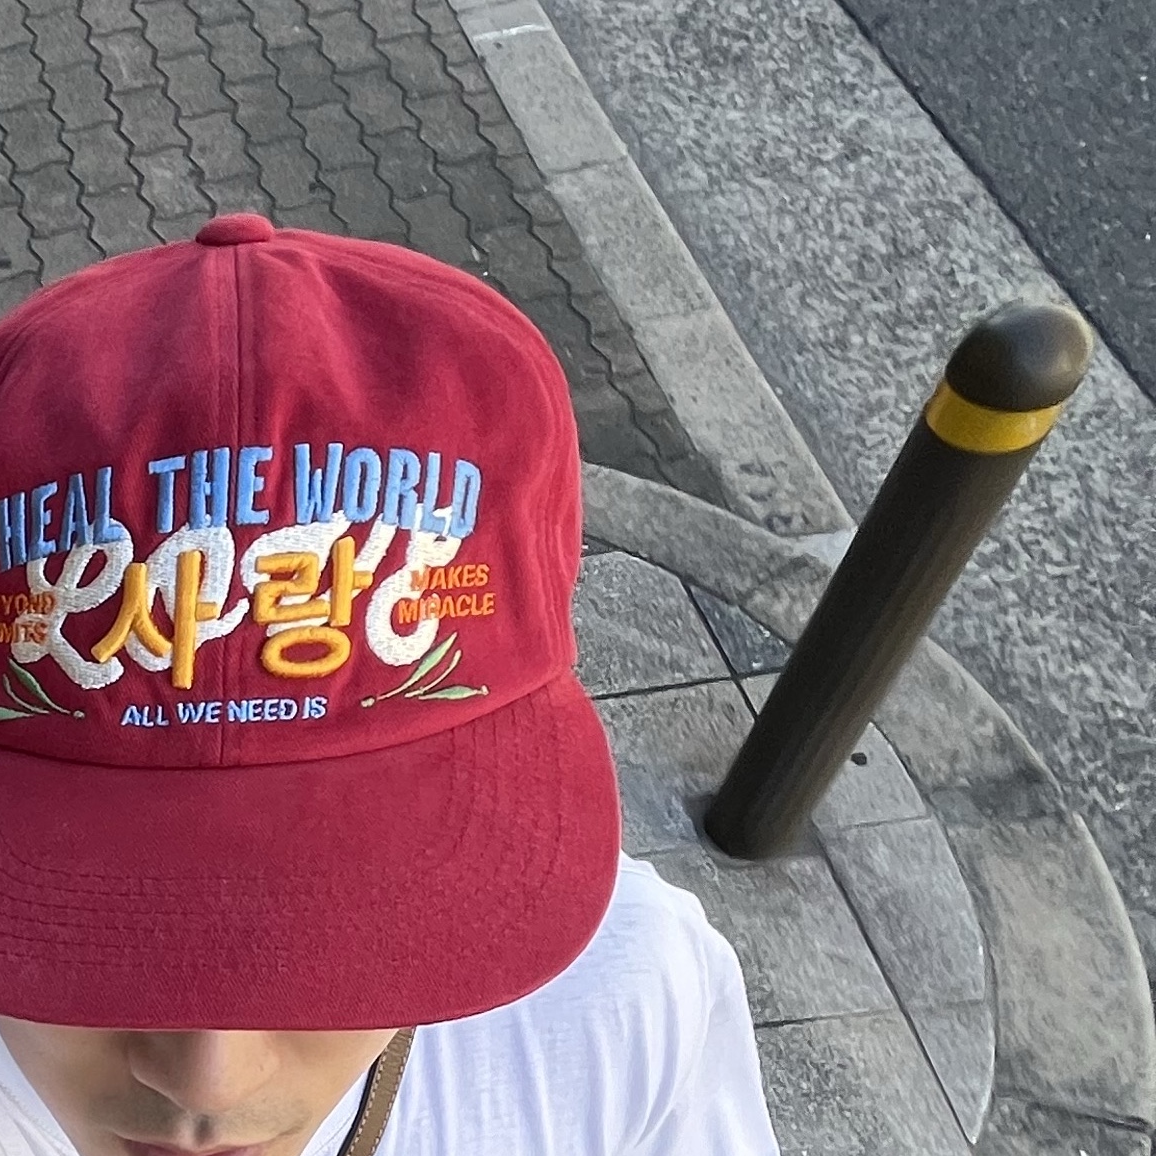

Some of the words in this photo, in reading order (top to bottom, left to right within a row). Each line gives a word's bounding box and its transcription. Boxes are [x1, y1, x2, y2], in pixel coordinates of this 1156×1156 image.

[148, 446, 273, 534] THE
[294, 442, 482, 539] WORLD
[410, 563, 490, 592] MAKES
[90, 536, 373, 689] 사랑
[398, 592, 497, 625] MIRACLE
[120, 704, 170, 728] ALL
[177, 701, 224, 725] WE
[227, 698, 298, 724] NEED
[302, 695, 328, 720] IS
